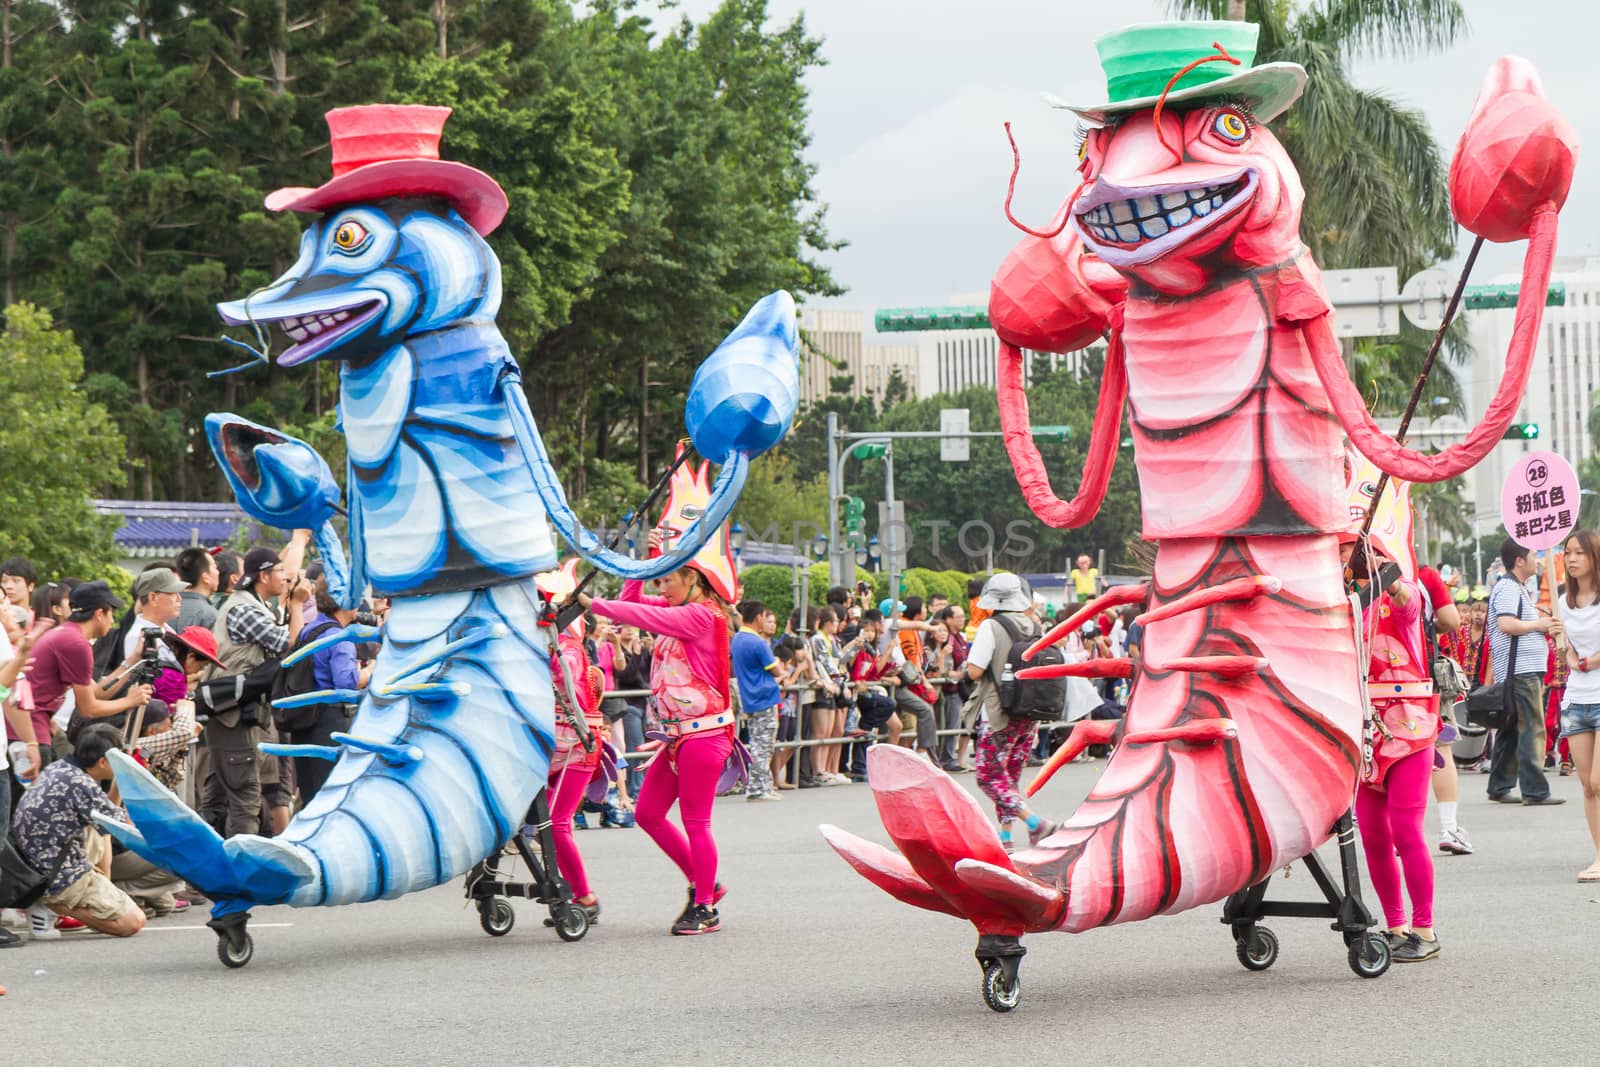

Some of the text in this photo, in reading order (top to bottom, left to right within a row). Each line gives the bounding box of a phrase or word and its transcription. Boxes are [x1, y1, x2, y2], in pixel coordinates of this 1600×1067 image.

[1528, 465, 1547, 481] 28
[1515, 486, 1566, 515] 粉紅色
[1515, 509, 1573, 539] 森巴之星
